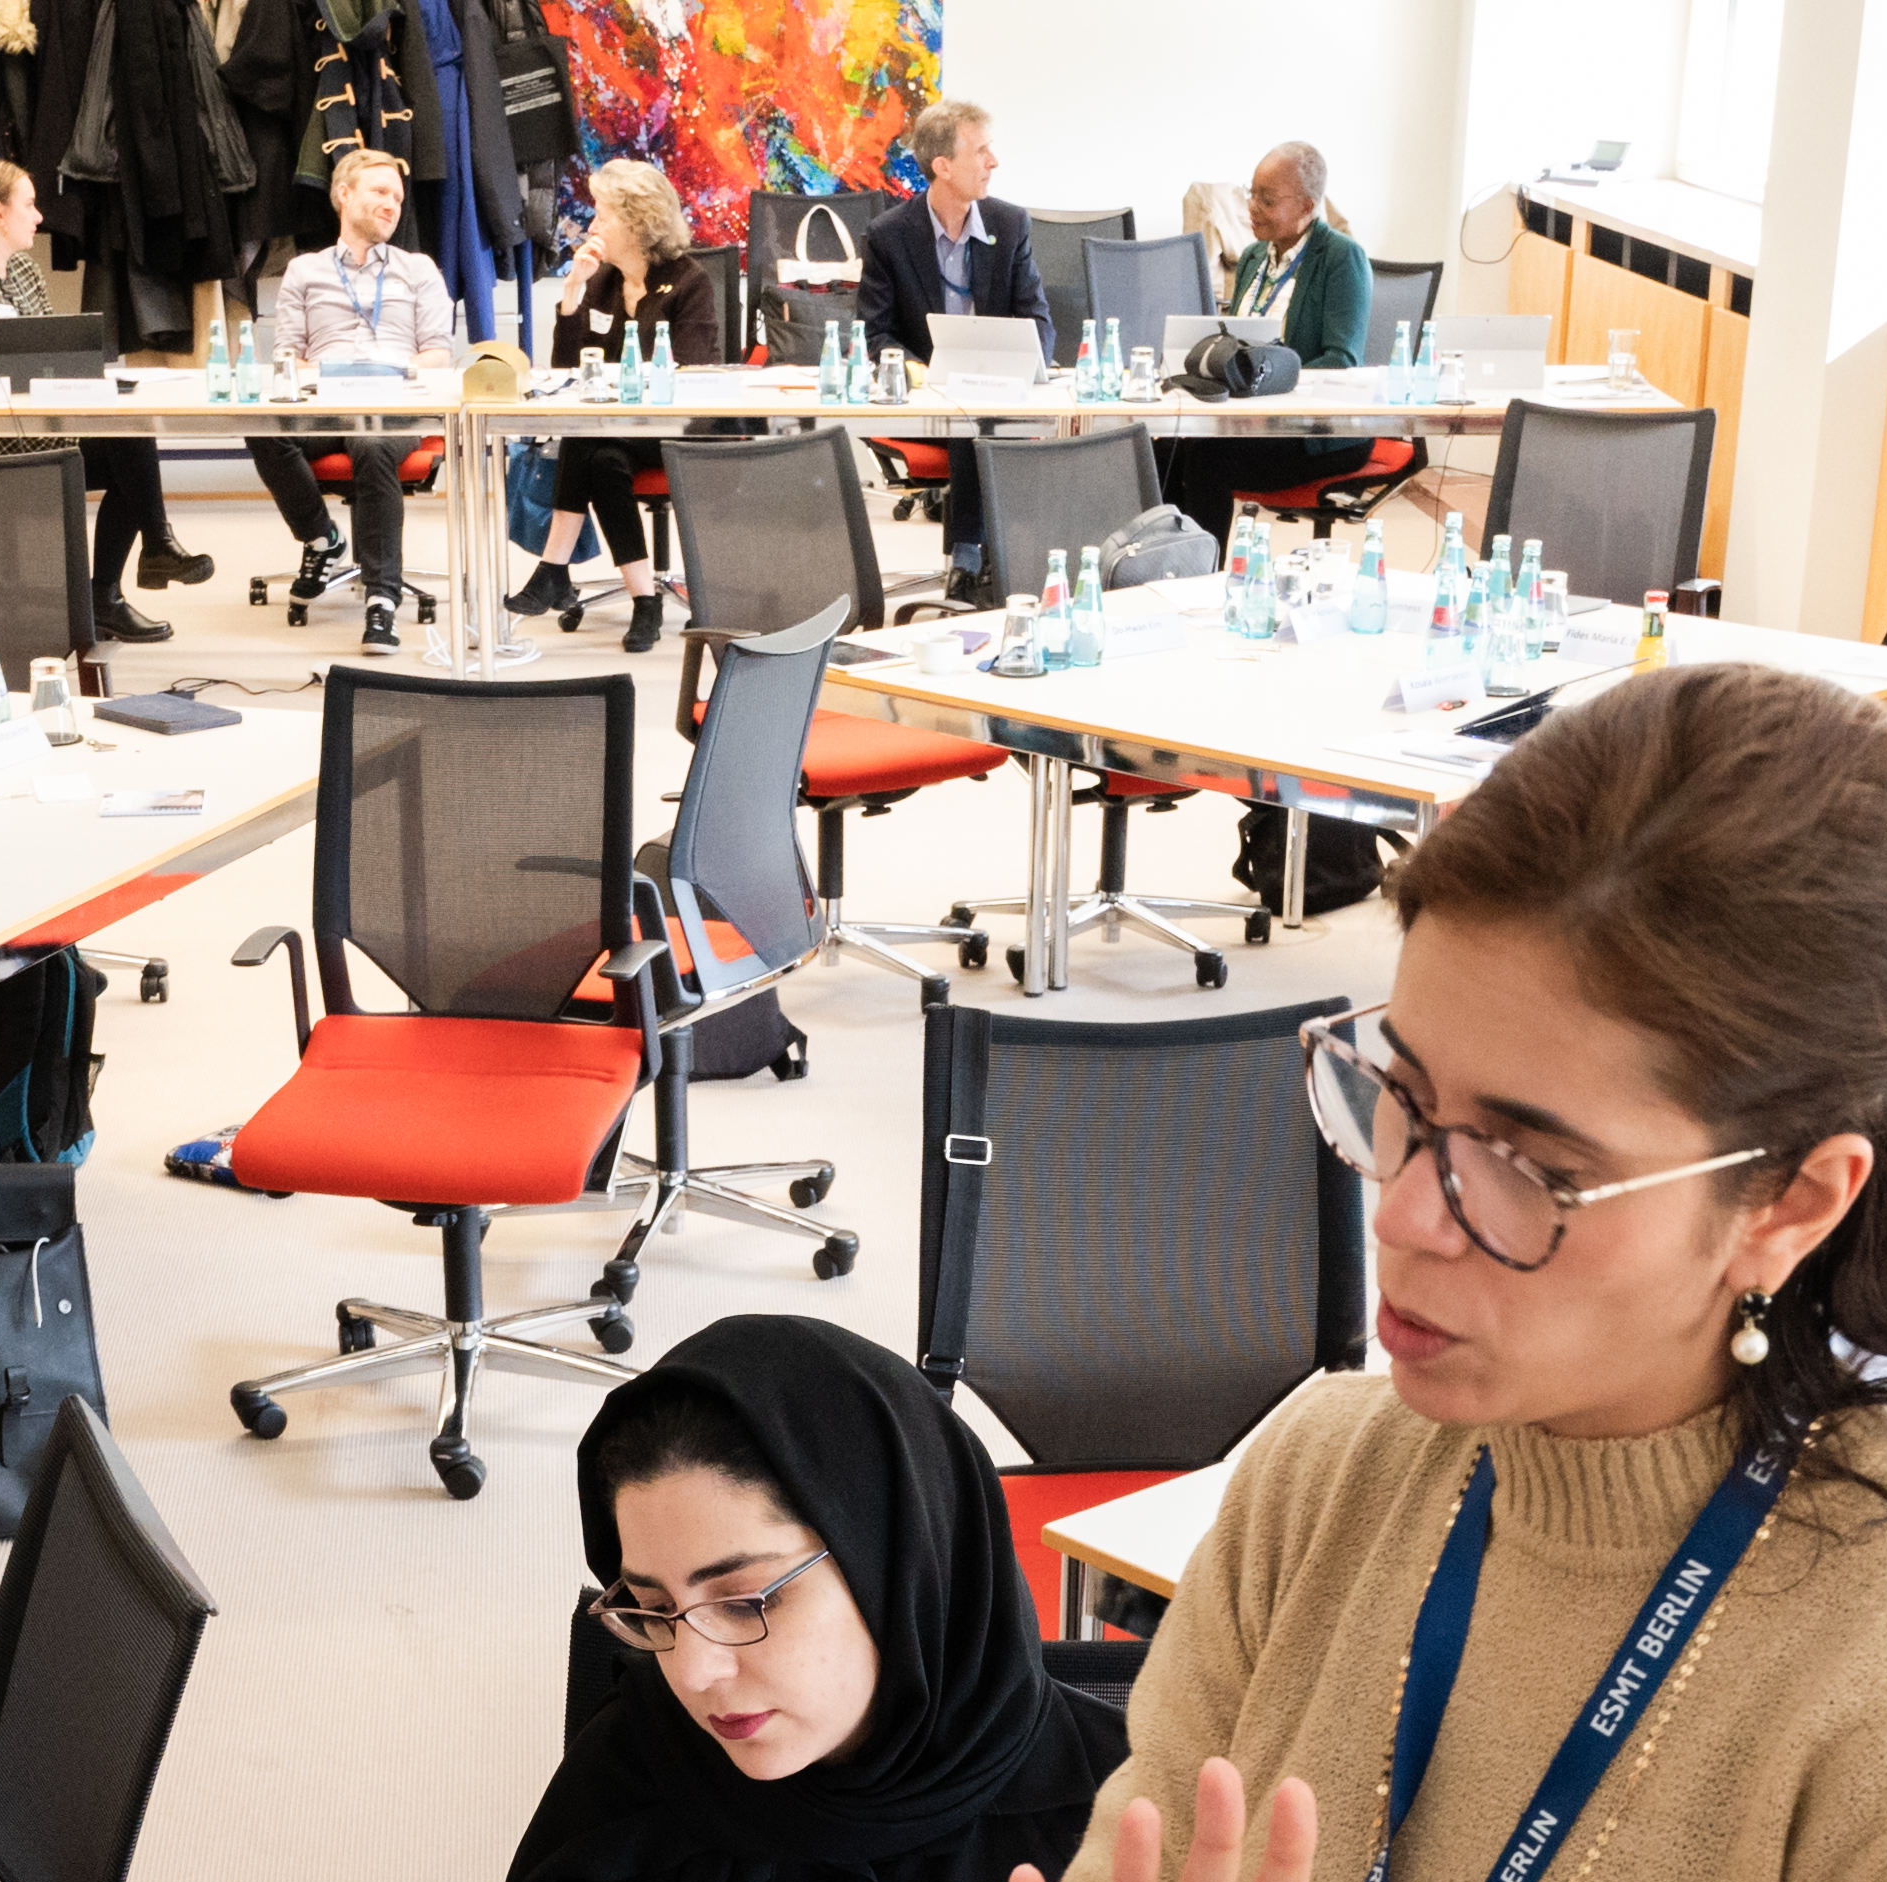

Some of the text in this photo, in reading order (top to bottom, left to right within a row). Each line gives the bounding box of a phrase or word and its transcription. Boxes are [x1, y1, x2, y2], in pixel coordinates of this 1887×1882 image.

[1384, 600, 1421, 613] uinness
[1589, 1558, 1712, 1737] ESMT BERLIN
